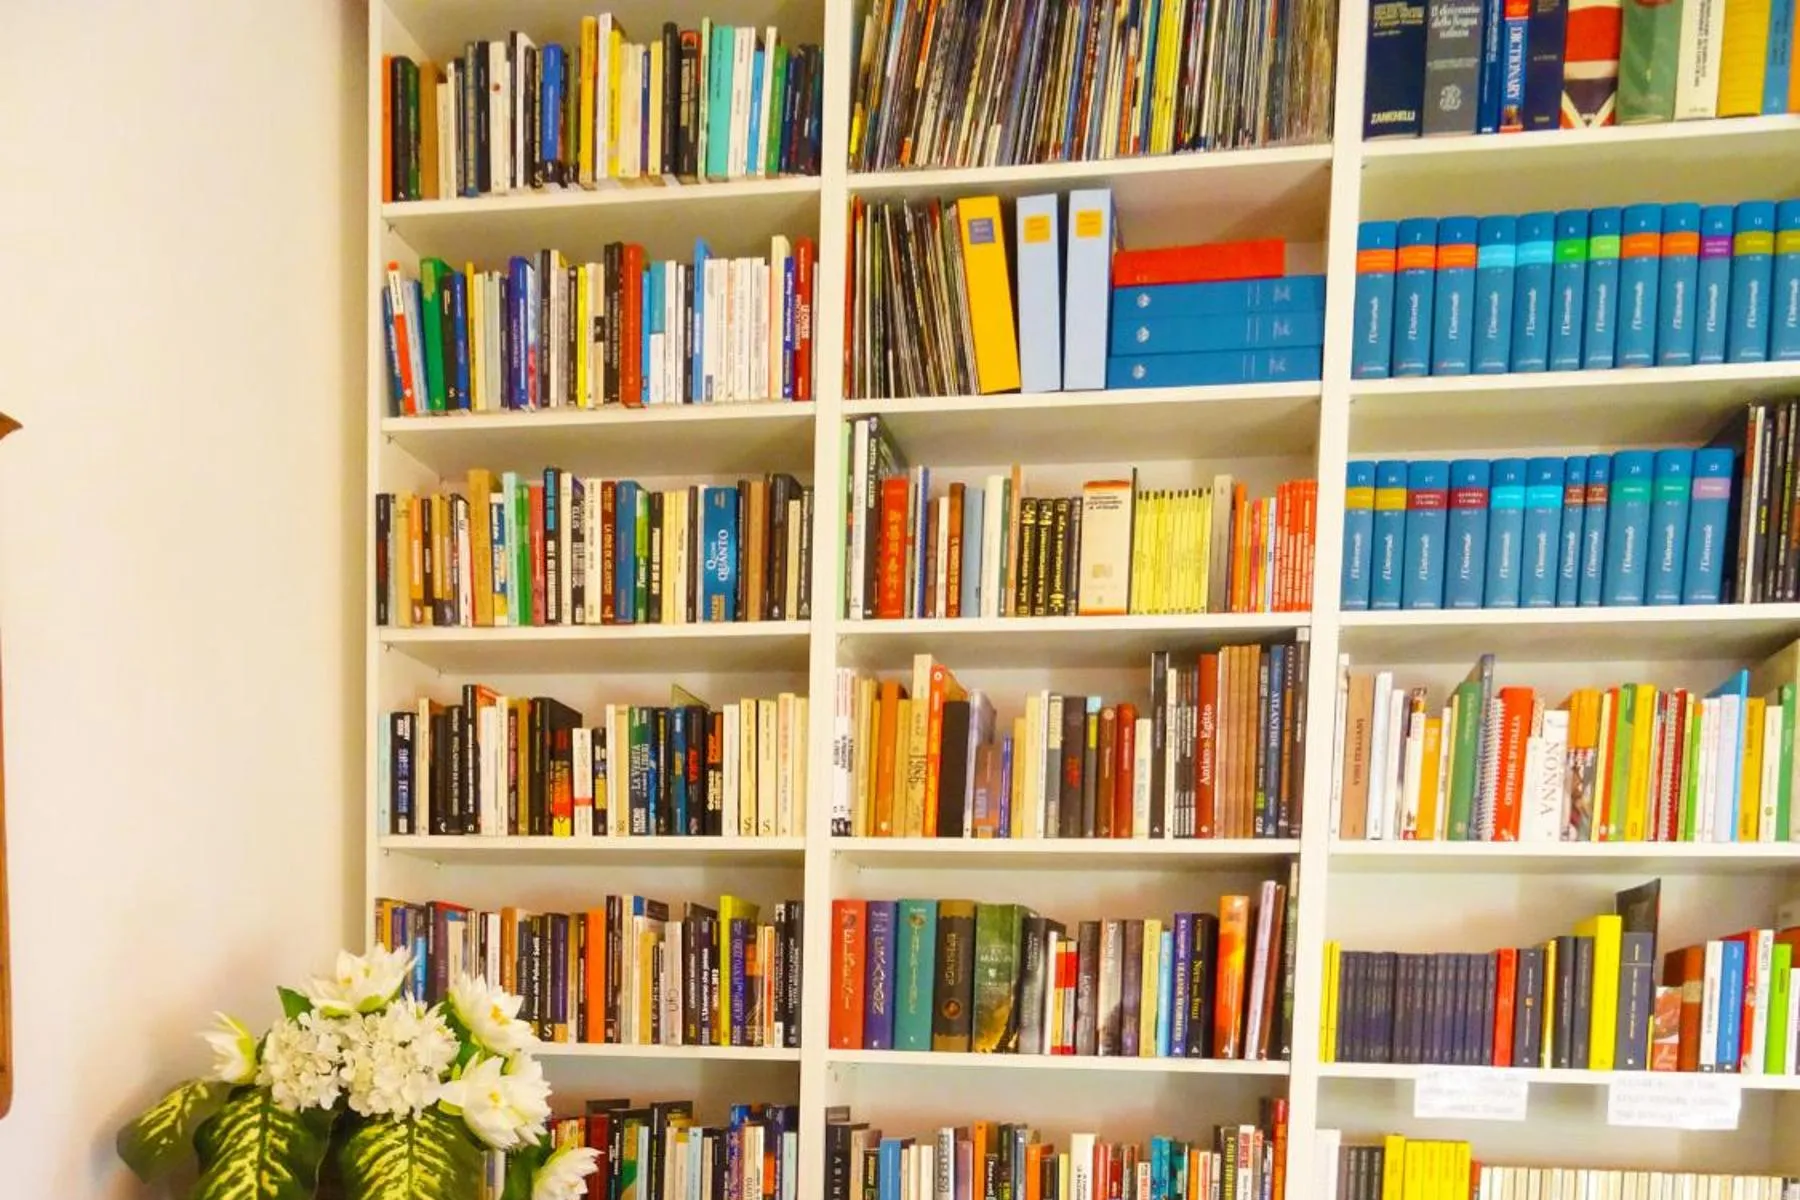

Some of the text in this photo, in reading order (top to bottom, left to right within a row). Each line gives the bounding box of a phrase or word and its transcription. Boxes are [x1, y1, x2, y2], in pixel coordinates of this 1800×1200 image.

[717, 529, 730, 582] QUANTO
[1199, 703, 1214, 786] Antico Egitto
[1541, 741, 1560, 816] NONNA
